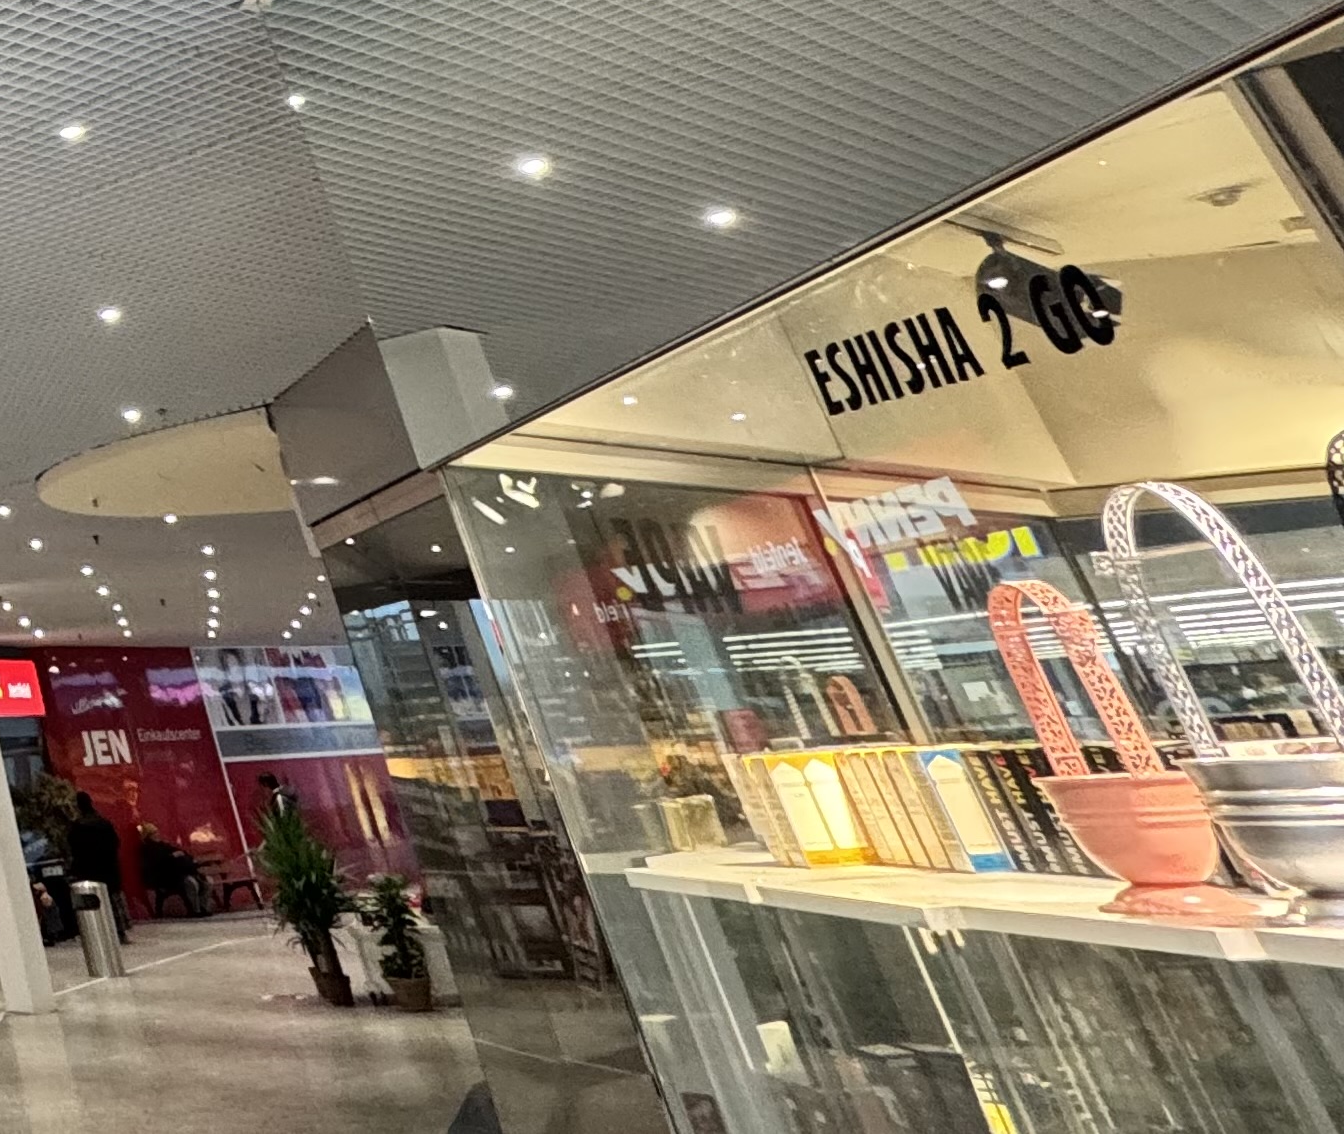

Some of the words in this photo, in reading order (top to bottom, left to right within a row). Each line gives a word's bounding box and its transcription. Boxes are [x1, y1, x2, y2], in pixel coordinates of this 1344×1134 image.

[804, 306, 986, 416] ESHISHA
[976, 293, 1031, 370] 2
[1028, 264, 1116, 355] GO
[81, 729, 133, 767] JEN
